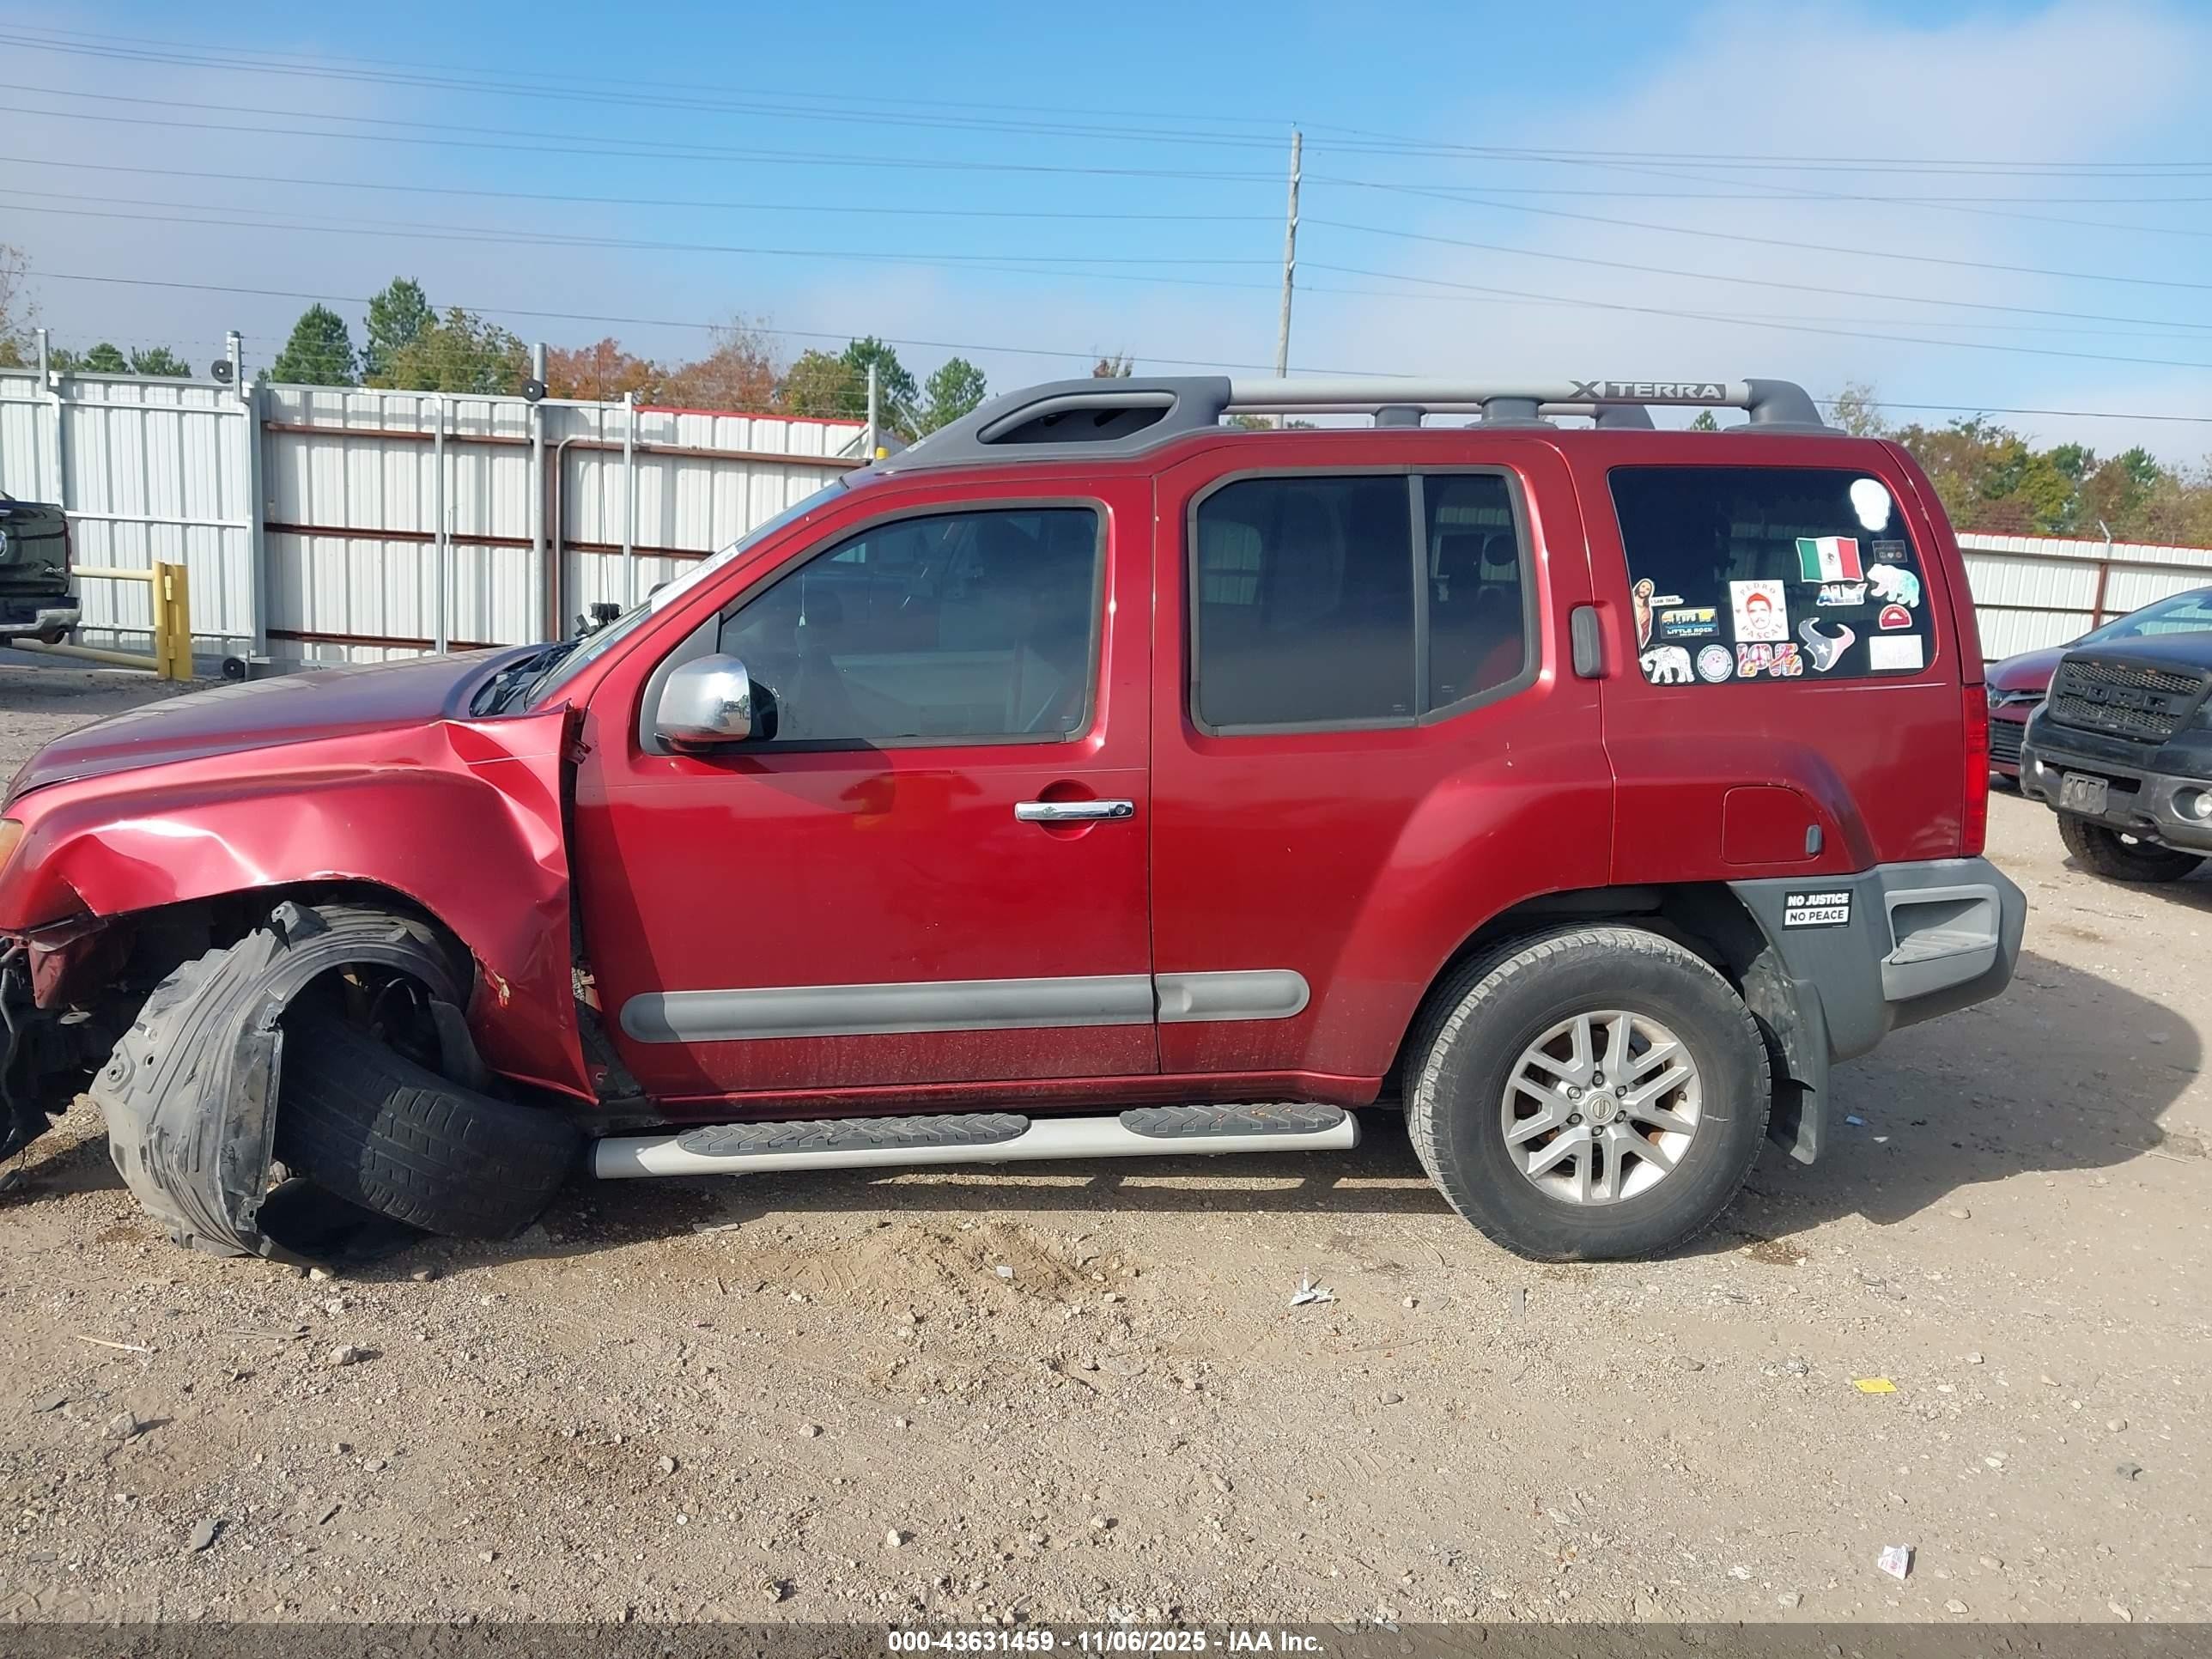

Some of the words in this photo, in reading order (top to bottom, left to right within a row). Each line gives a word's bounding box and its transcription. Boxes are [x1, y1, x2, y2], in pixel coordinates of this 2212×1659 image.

[1740, 583, 1776, 596] PEDRO
[1741, 623, 1783, 639] PASCAL
[1736, 643, 1803, 678] LOVE
[1788, 895, 1805, 906] NO
[1805, 893, 1850, 905] JUSTICE
[1790, 912, 1806, 921] NO
[1808, 909, 1844, 921] PEACE
